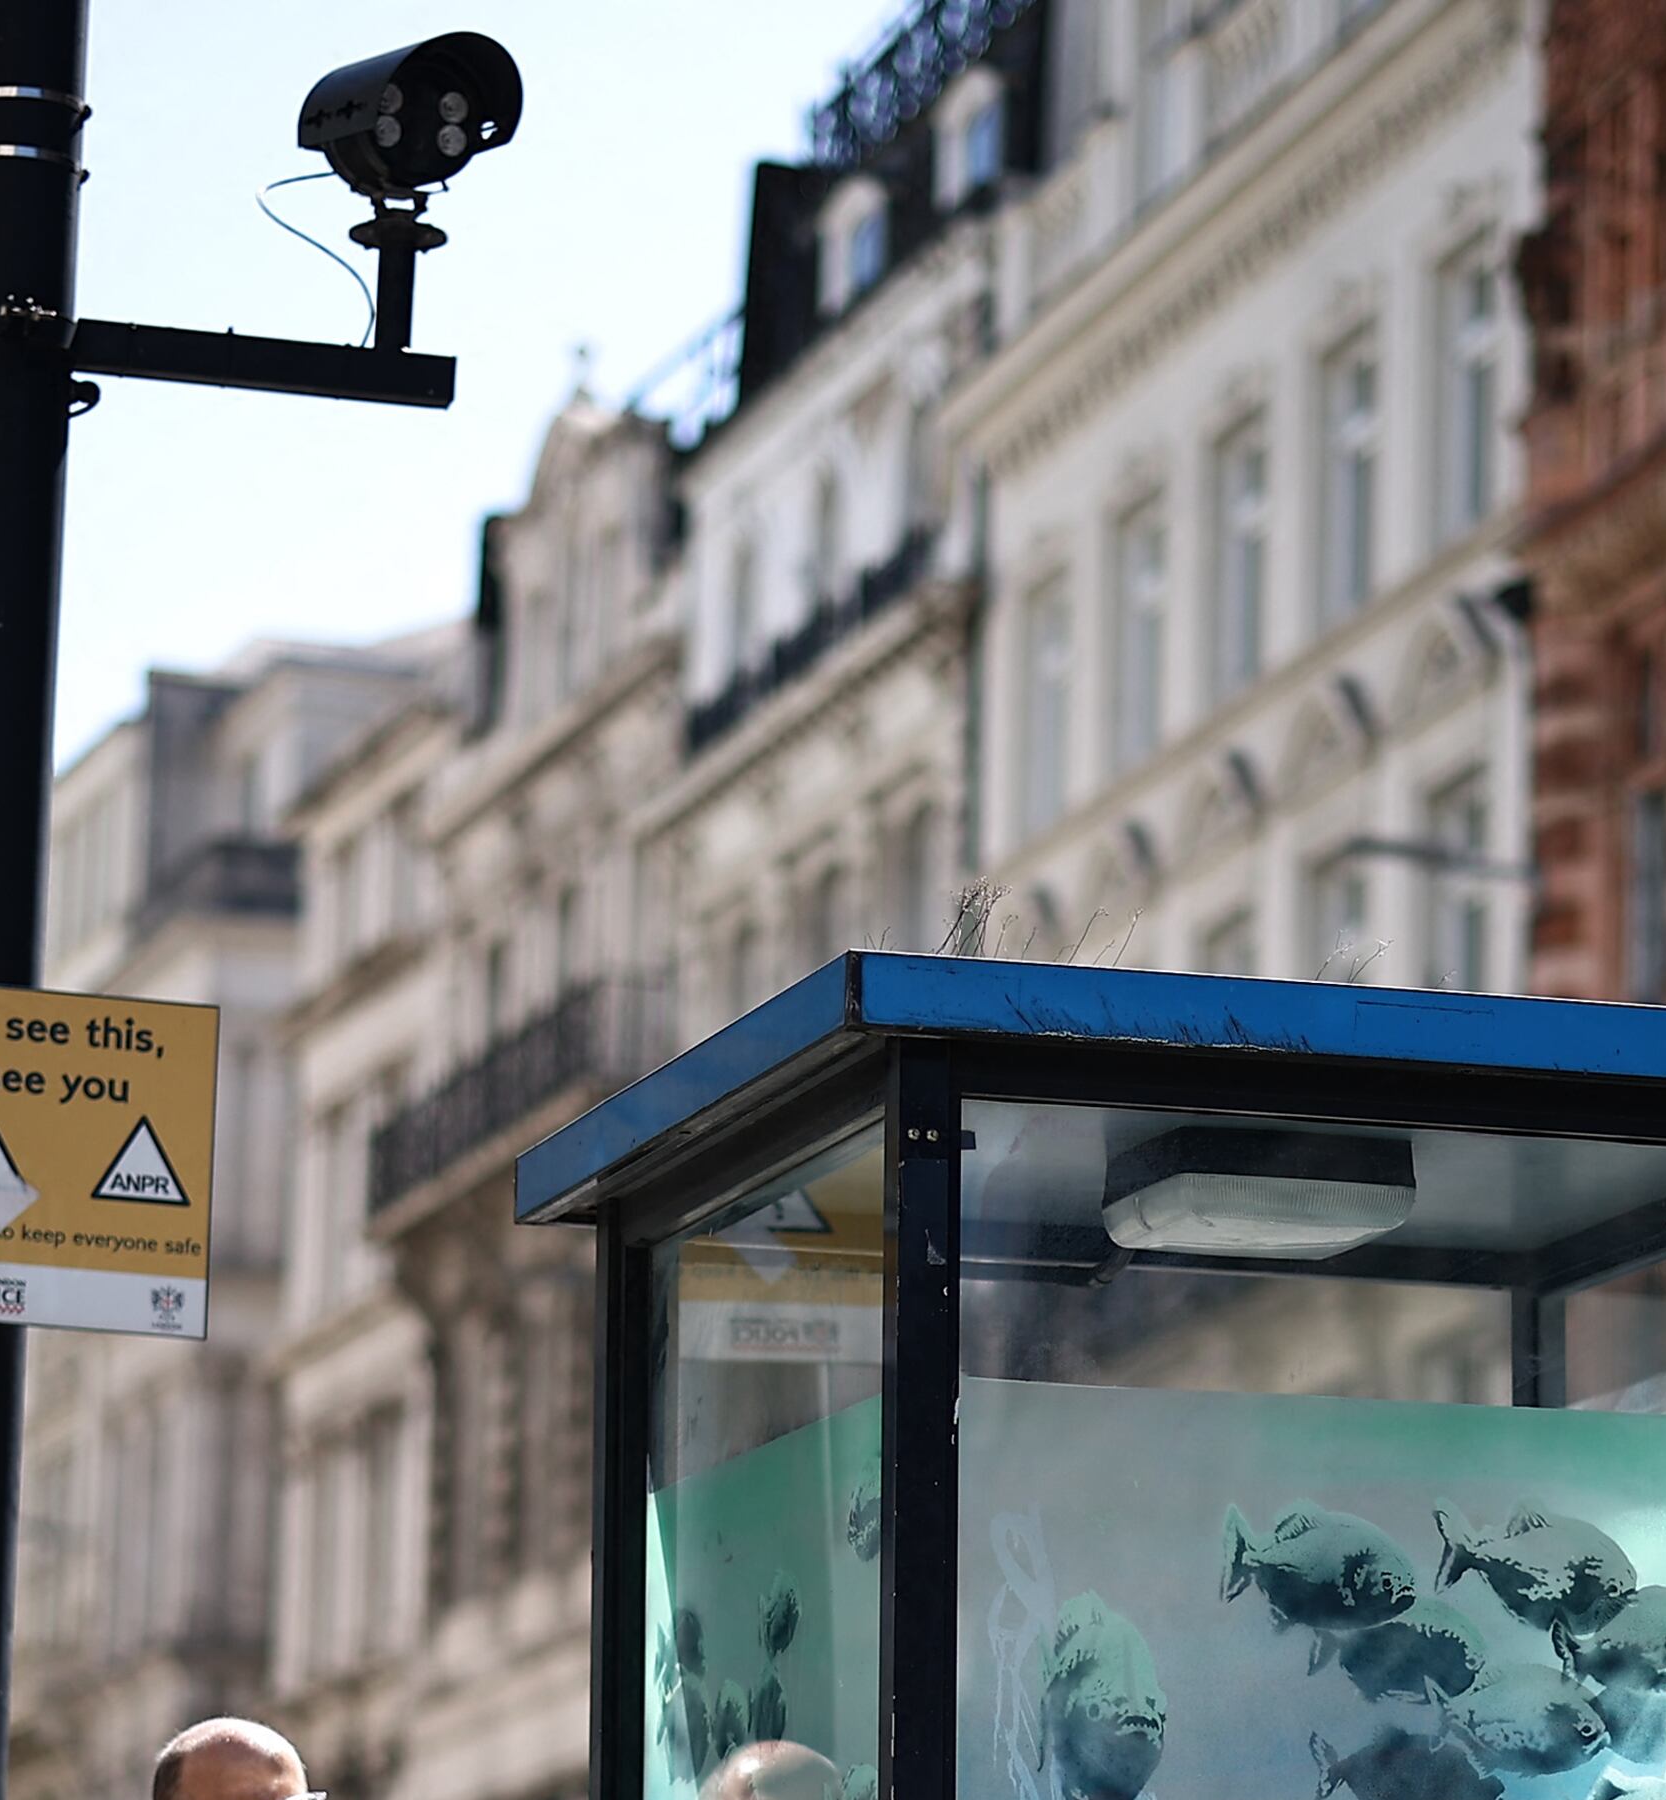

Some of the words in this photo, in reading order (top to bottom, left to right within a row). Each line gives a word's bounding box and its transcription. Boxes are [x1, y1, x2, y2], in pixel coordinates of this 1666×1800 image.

[6, 1017, 70, 1045] see
[86, 1018, 165, 1059] this,
[60, 1074, 130, 1104] you
[110, 1173, 169, 1195] ANPR
[22, 1224, 66, 1247] keep
[73, 1231, 158, 1252] everyone
[165, 1237, 201, 1257] safe
